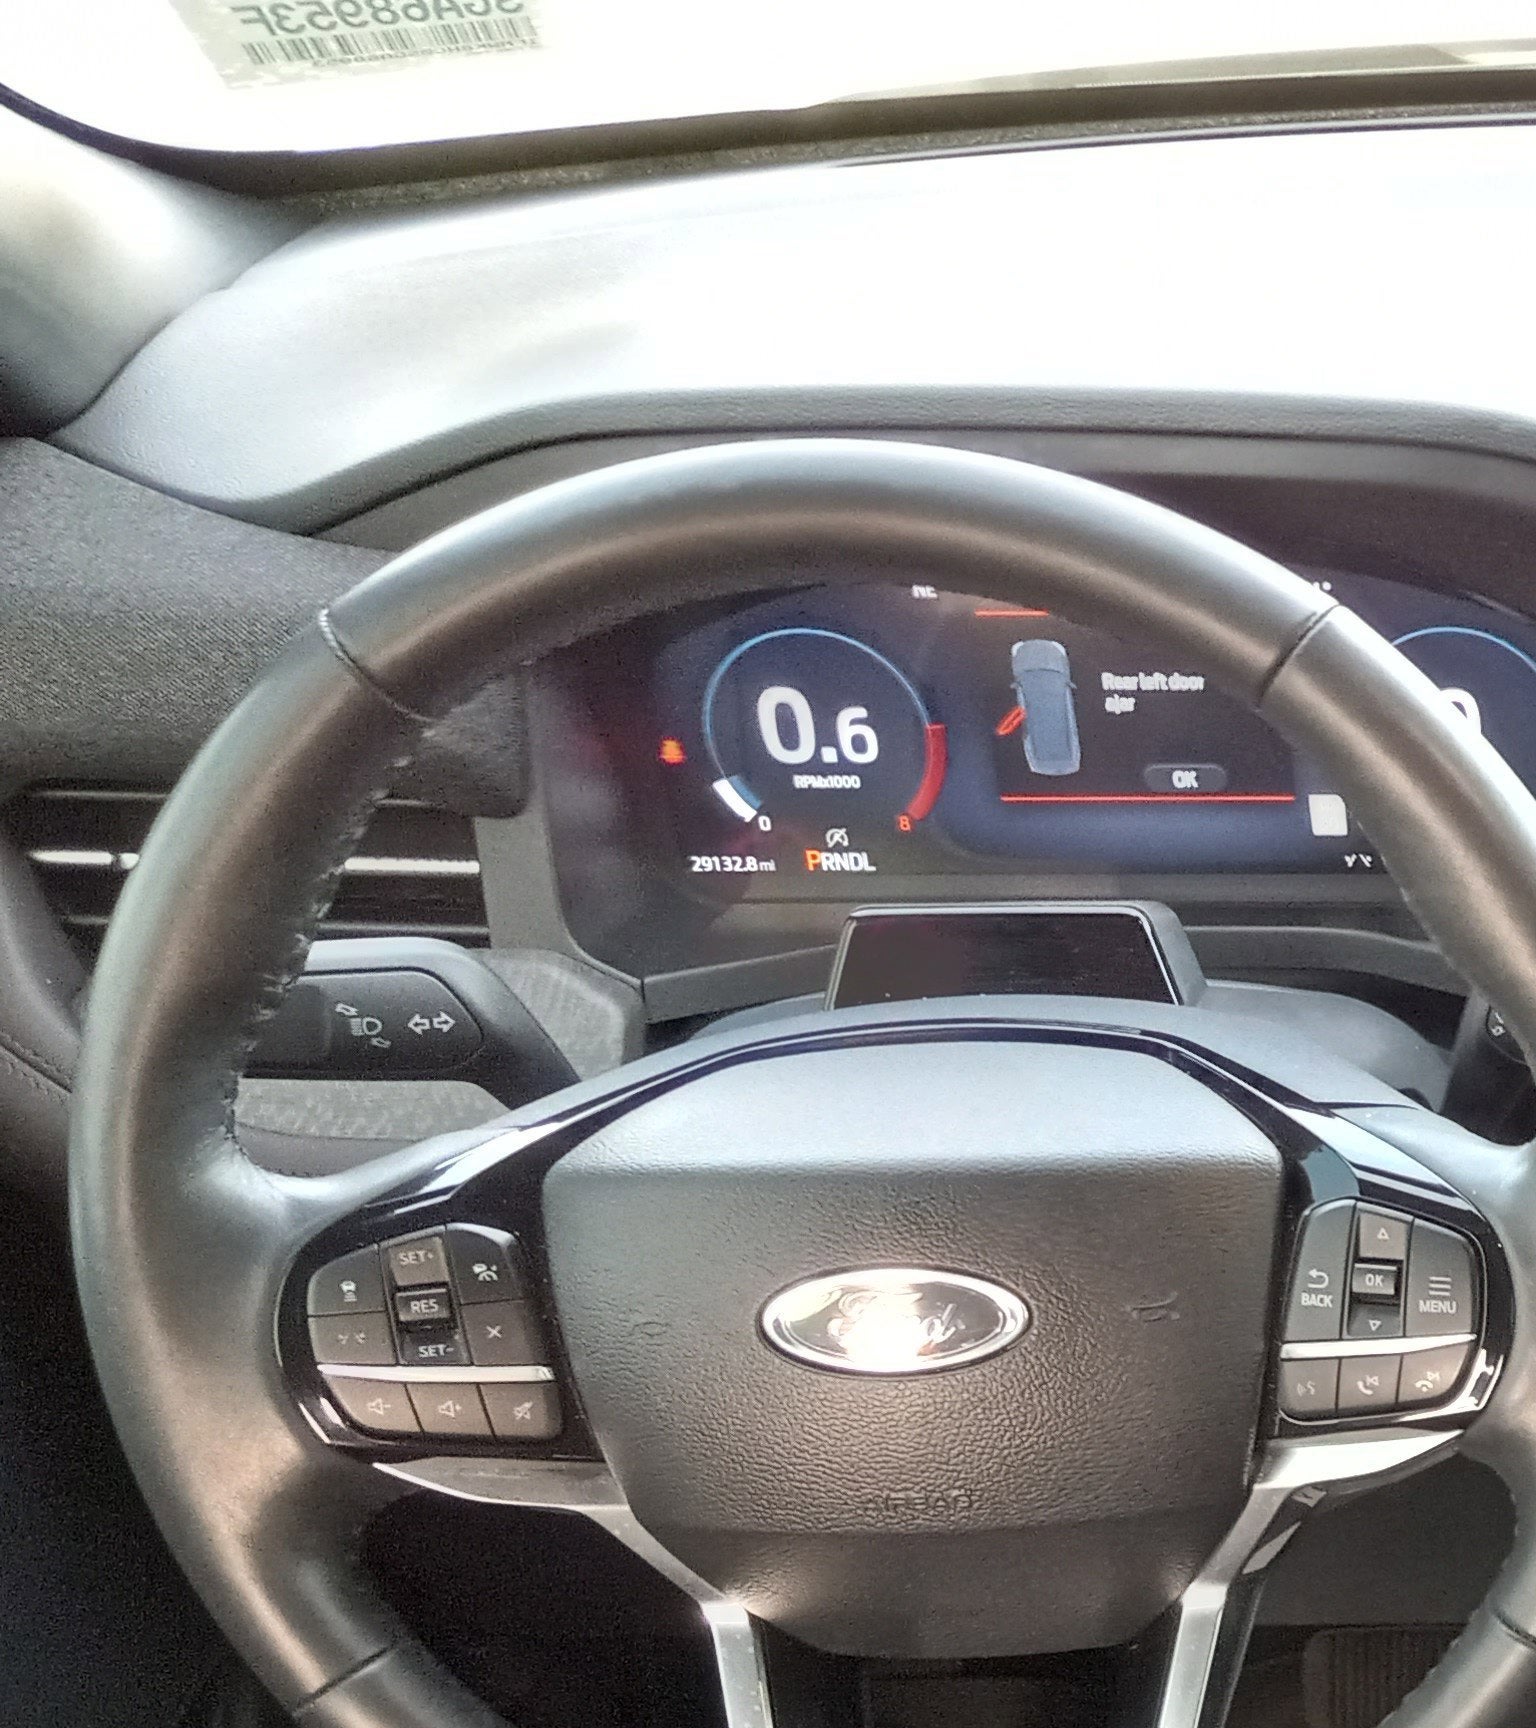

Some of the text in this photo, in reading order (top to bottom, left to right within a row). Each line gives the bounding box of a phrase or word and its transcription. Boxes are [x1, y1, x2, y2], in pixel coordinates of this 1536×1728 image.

[1101, 671, 1205, 691] Rear left door
[1104, 693, 1135, 715] ajar
[757, 685, 879, 765] 0.6
[793, 774, 861, 789] RPMx1000
[1172, 769, 1199, 788] OK
[757, 815, 772, 832] 0
[897, 814, 911, 832] 8
[690, 855, 758, 872] 29132.8
[804, 849, 877, 871] PRNDL
[1365, 1273, 1385, 1288] OK
[410, 1299, 440, 1314] RES
[1301, 1292, 1333, 1308] BACK
[1419, 1300, 1456, 1314] MENU
